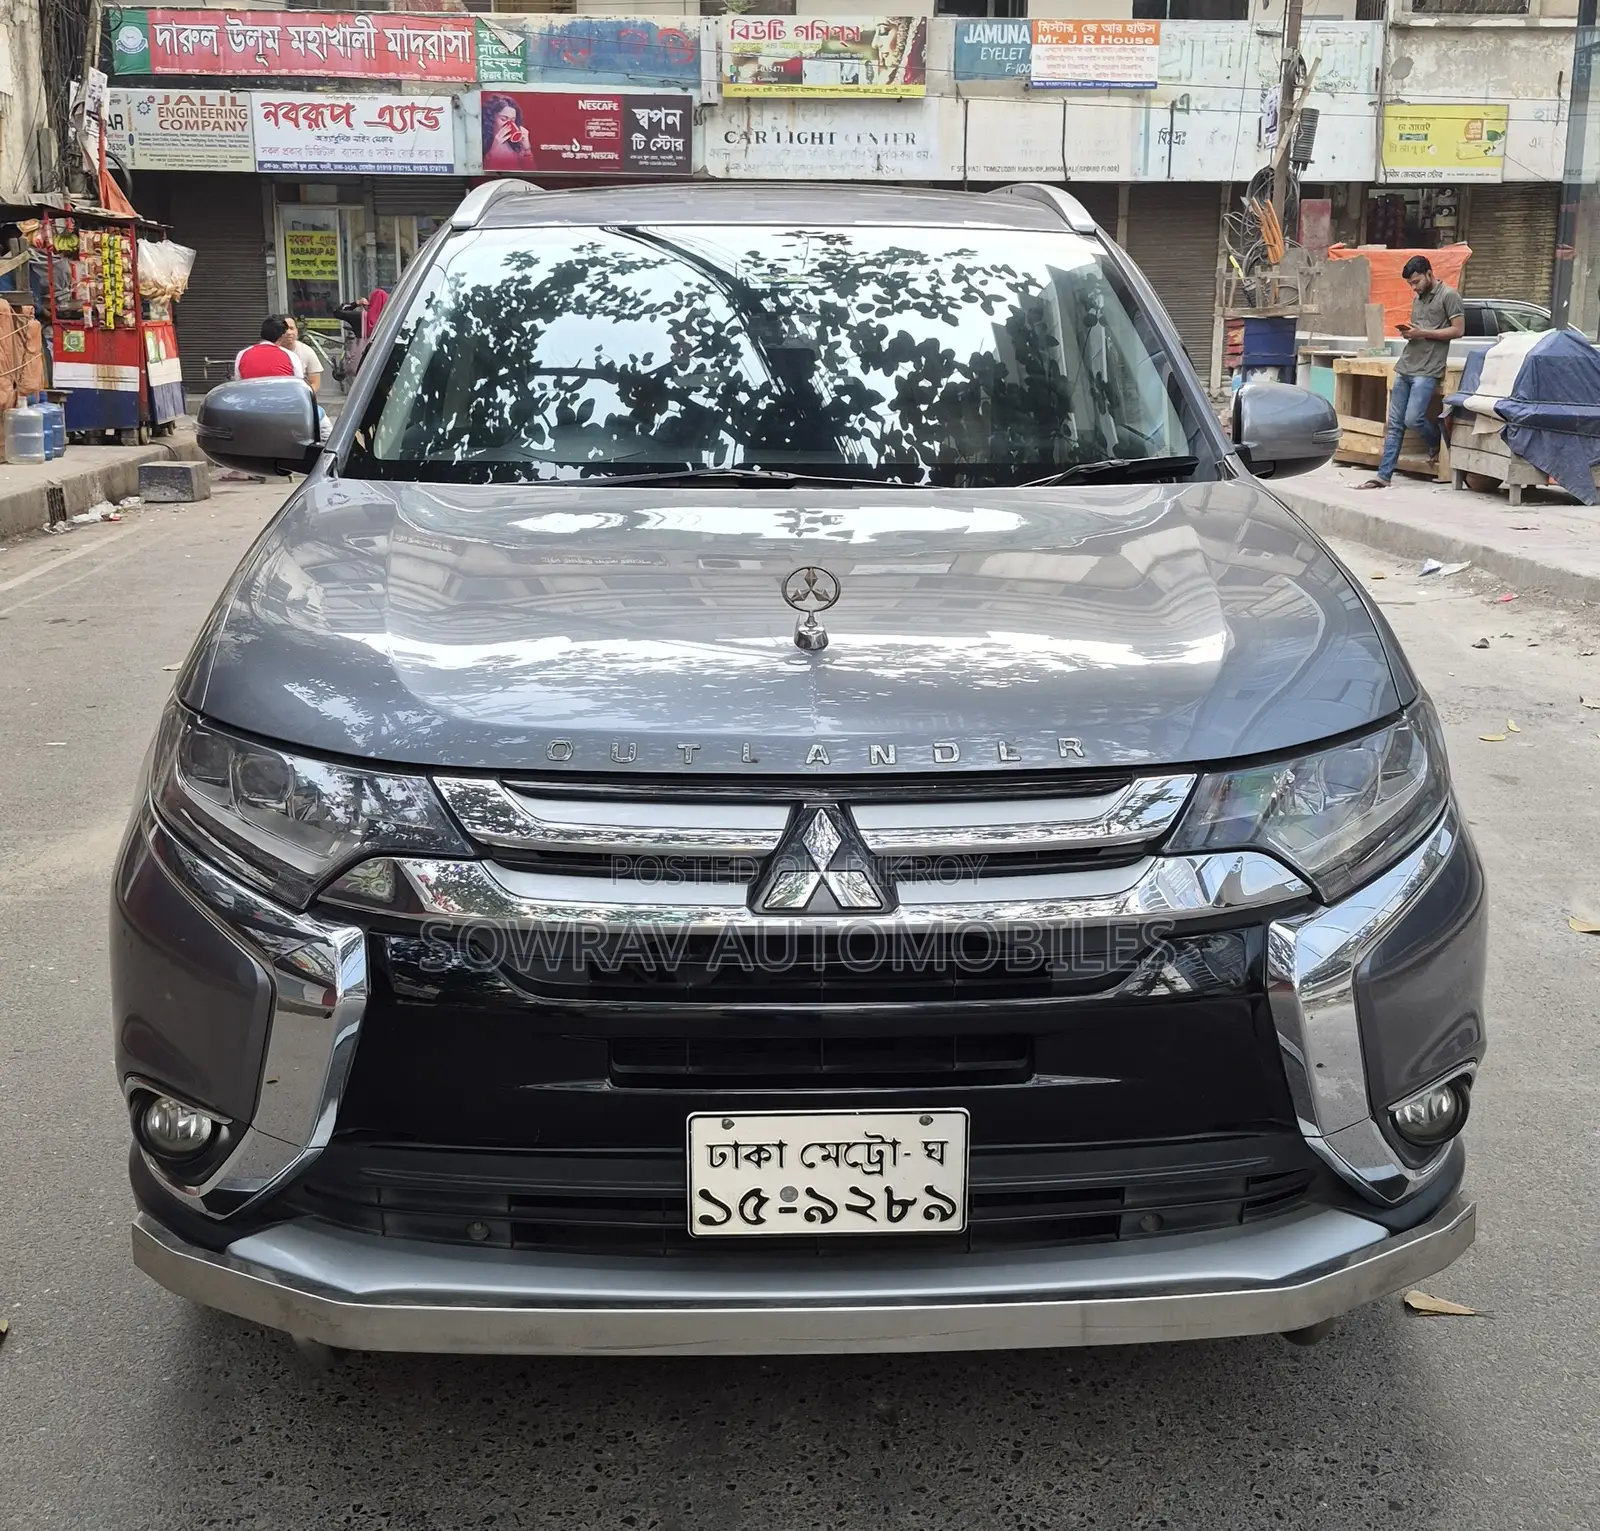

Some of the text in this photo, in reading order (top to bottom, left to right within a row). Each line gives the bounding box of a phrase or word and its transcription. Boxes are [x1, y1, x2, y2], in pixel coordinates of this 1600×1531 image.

[730, 19, 787, 42] বিউটি
[964, 24, 1030, 44] JAMUNA
[1081, 23, 1098, 34] জে
[1101, 23, 1123, 34] আর
[1126, 22, 1156, 34] হাউস
[153, 20, 221, 56] দারুল
[224, 14, 283, 68] উলূম
[287, 15, 378, 62] মহাখালী
[1038, 35, 1155, 45] Mr. J R House
[980, 47, 1023, 61] EYELET
[156, 94, 248, 107] JALIL
[158, 107, 248, 120] ENGINEERING
[260, 101, 357, 130] নবরূপ
[631, 107, 684, 132] স্বপন
[158, 120, 248, 132] COMPANY
[630, 133, 685, 152] টি স্টোর
[724, 130, 768, 145] CAR
[774, 131, 838, 146] LIGHT
[290, 247, 335, 255] NABARUP AD
[545, 737, 1086, 763] OUTLANDER
[706, 1139, 789, 1169] ঢাকা
[921, 1140, 950, 1166] ঘ
[697, 1184, 958, 1227] ১৫-৯২৮৯
